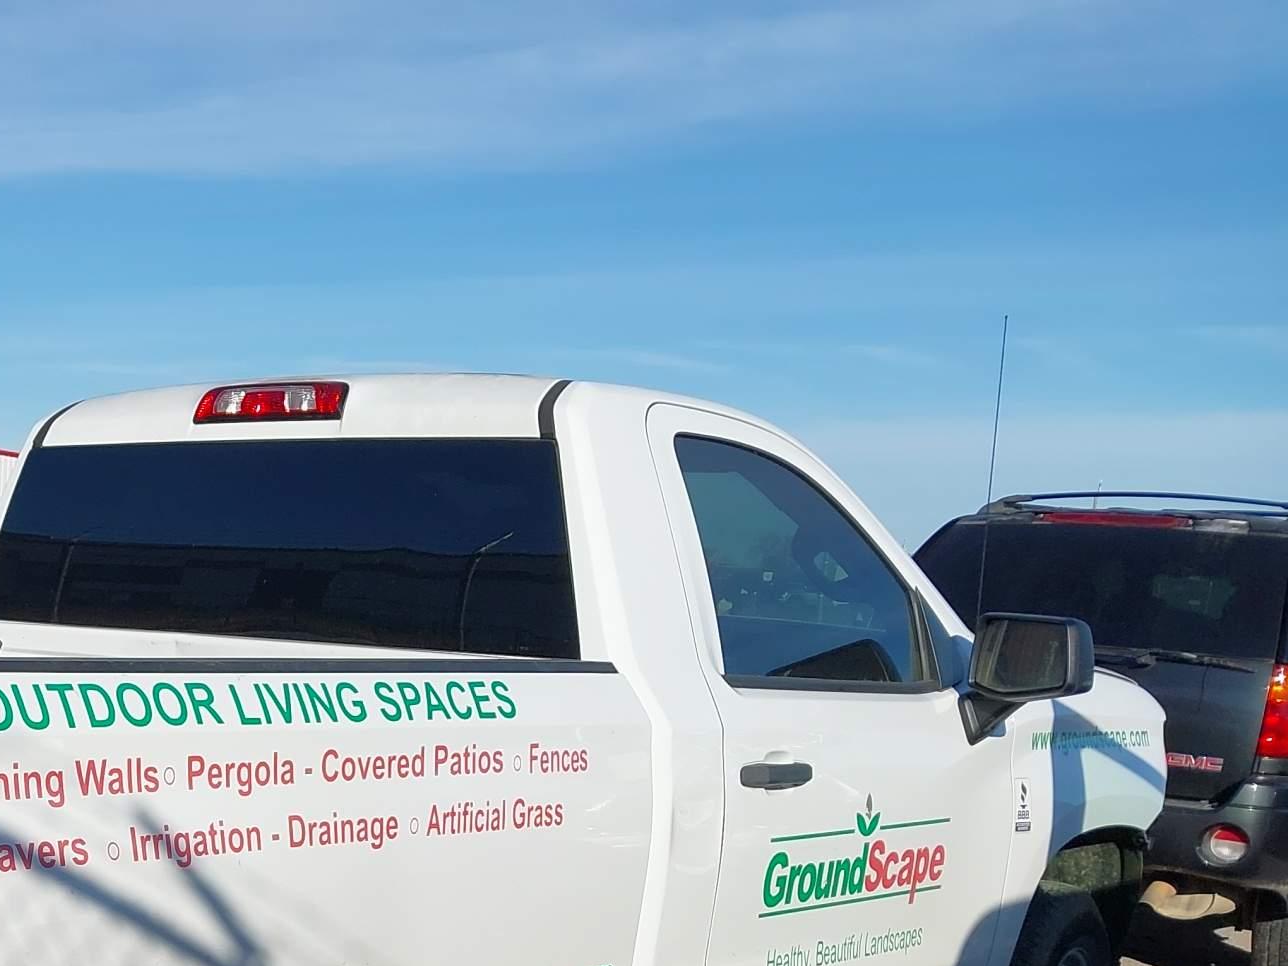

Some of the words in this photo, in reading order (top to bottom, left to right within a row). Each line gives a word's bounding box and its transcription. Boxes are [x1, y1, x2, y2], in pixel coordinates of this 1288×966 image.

[229, 682, 368, 726] LIVING
[374, 681, 517, 722] SPACES
[1031, 726, 1151, 756] www.groundscape.com
[1167, 752, 1224, 772] GMC
[75, 758, 160, 797] Walls
[187, 752, 296, 797] Pergola
[321, 747, 426, 783] Covered
[433, 744, 505, 777] Patios
[529, 744, 589, 774] Fences
[129, 819, 262, 869] Irrigation
[288, 811, 399, 850] Drainage
[427, 800, 506, 837] Artificial
[513, 799, 564, 828] Grass
[763, 840, 946, 905] GroundScape
[816, 933, 863, 966] Beautiful
[864, 927, 923, 958] Landscapes
